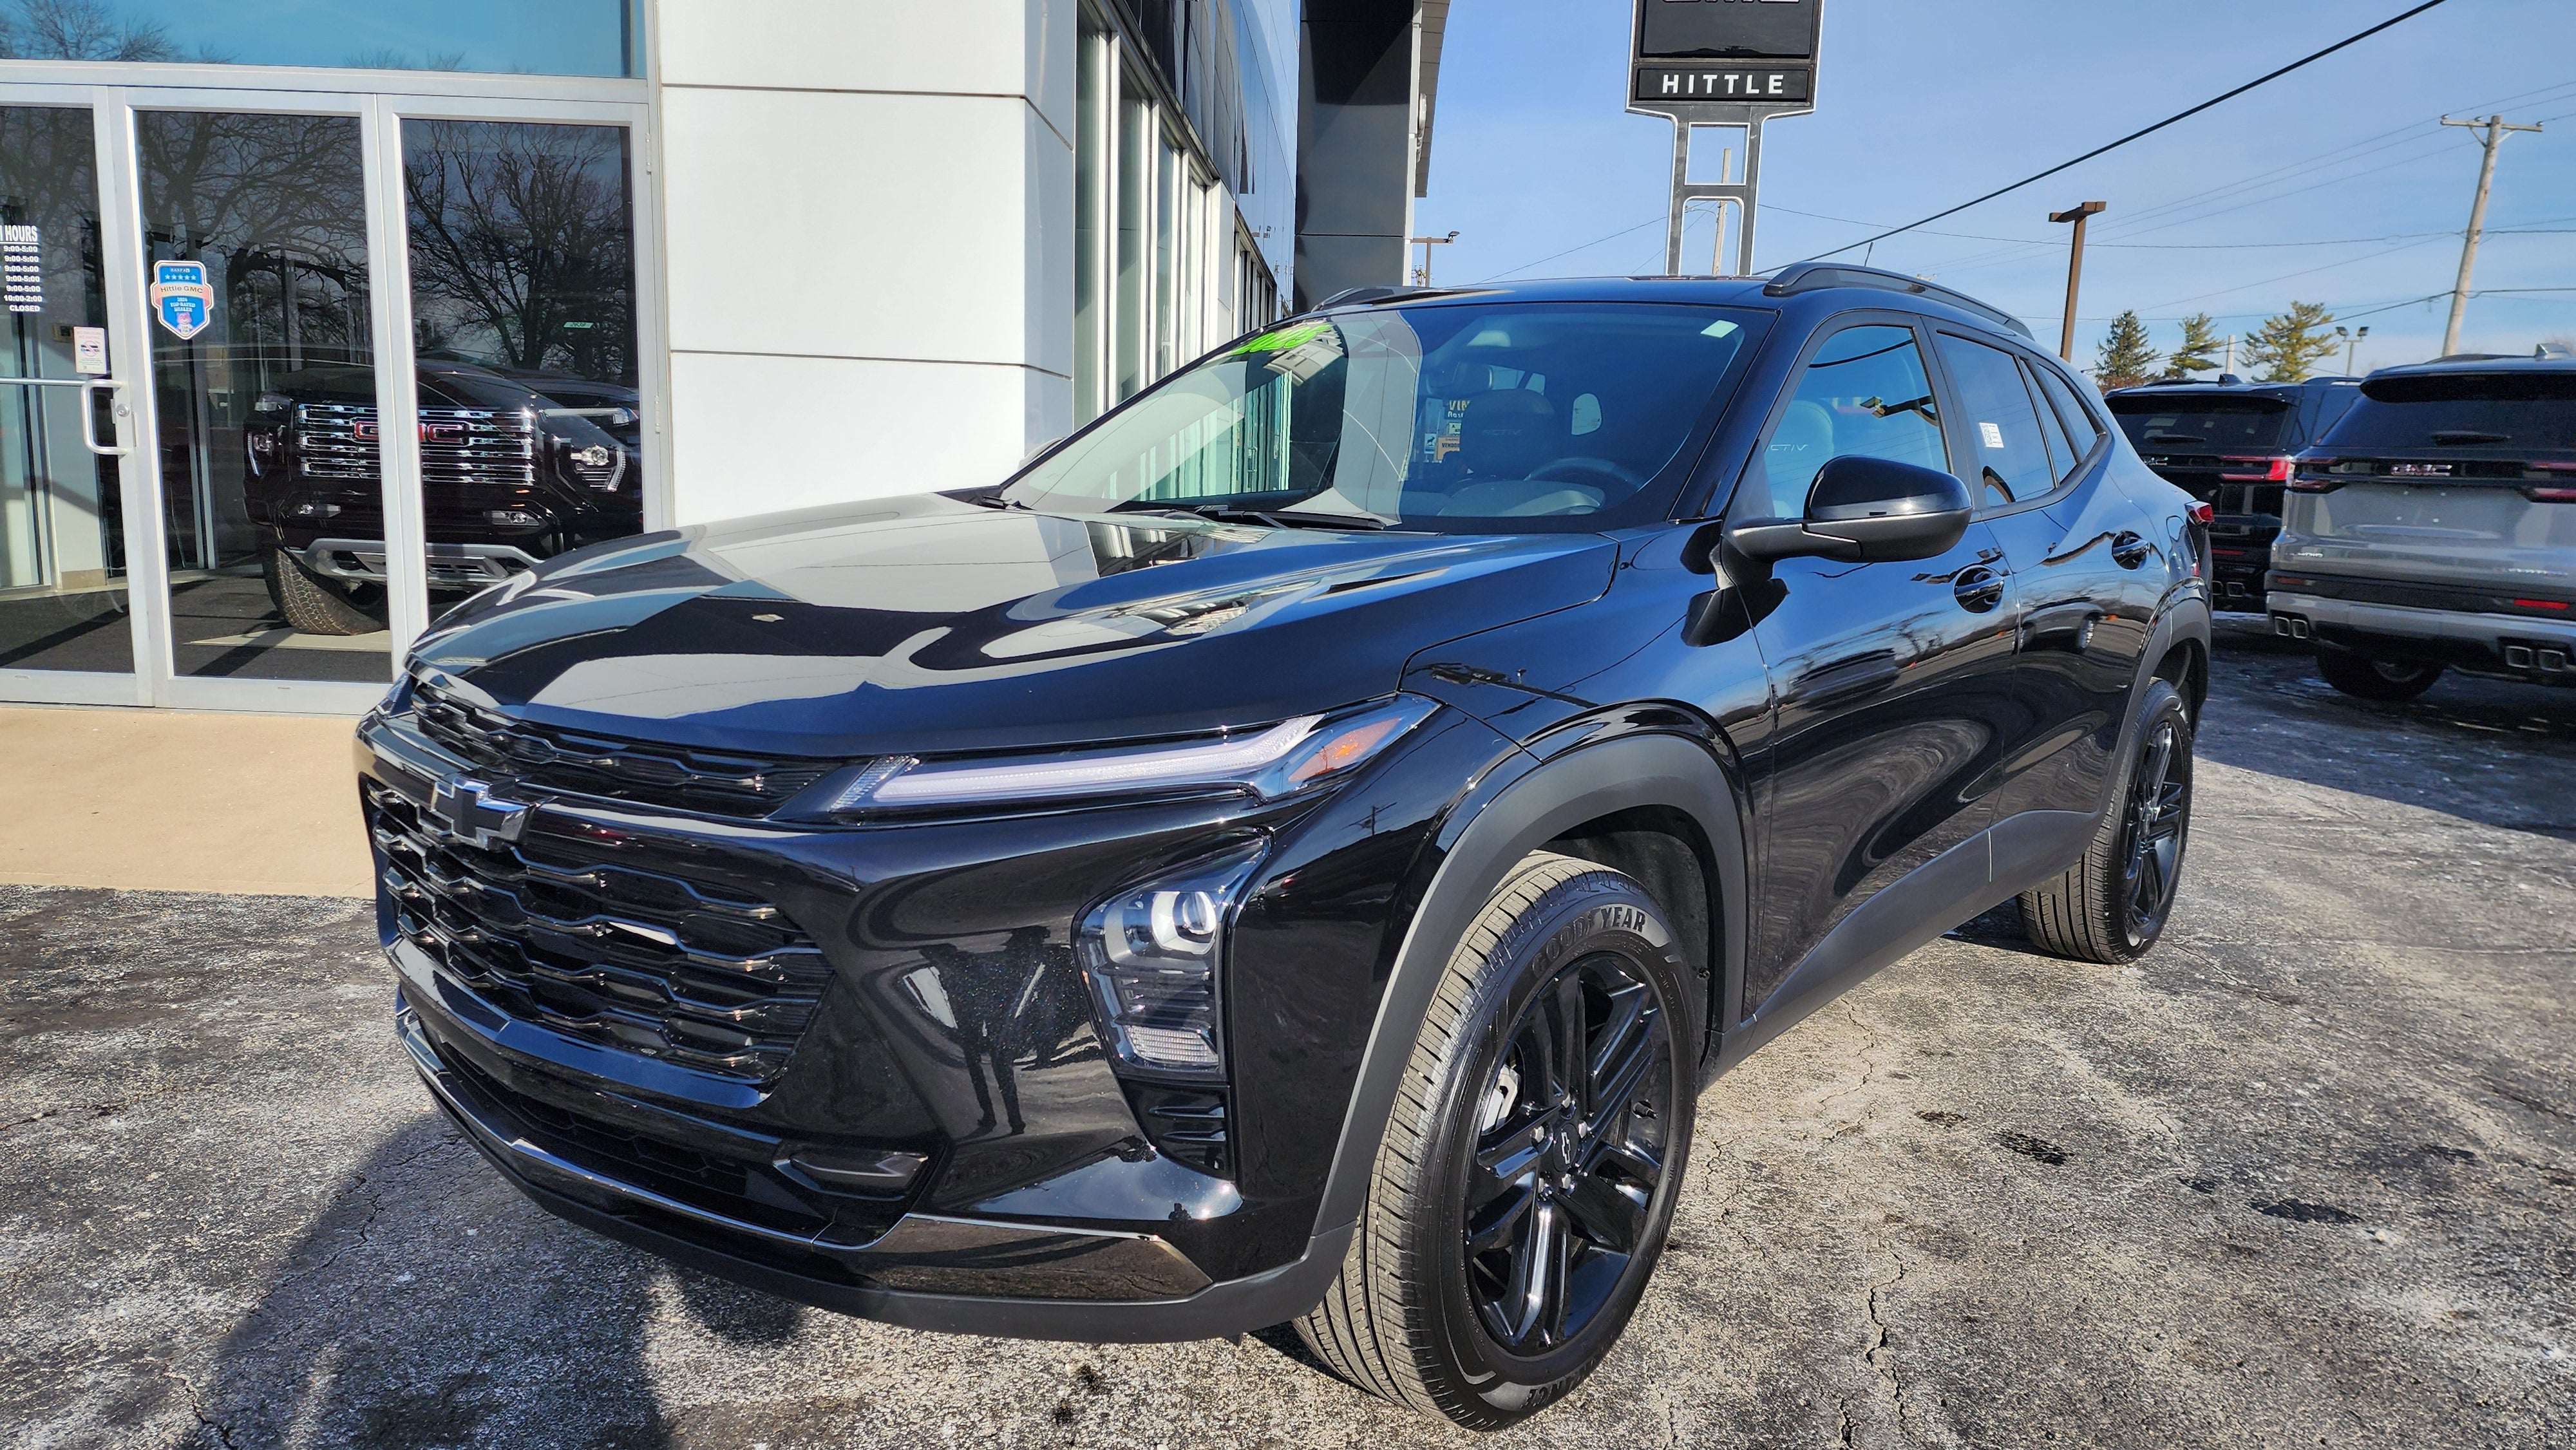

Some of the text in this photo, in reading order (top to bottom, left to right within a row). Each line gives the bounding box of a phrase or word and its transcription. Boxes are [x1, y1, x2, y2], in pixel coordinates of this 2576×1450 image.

[1662, 74, 1783, 94] HITTLE
[5, 225, 38, 242] HOURS
[2391, 464, 2452, 476] GMC
